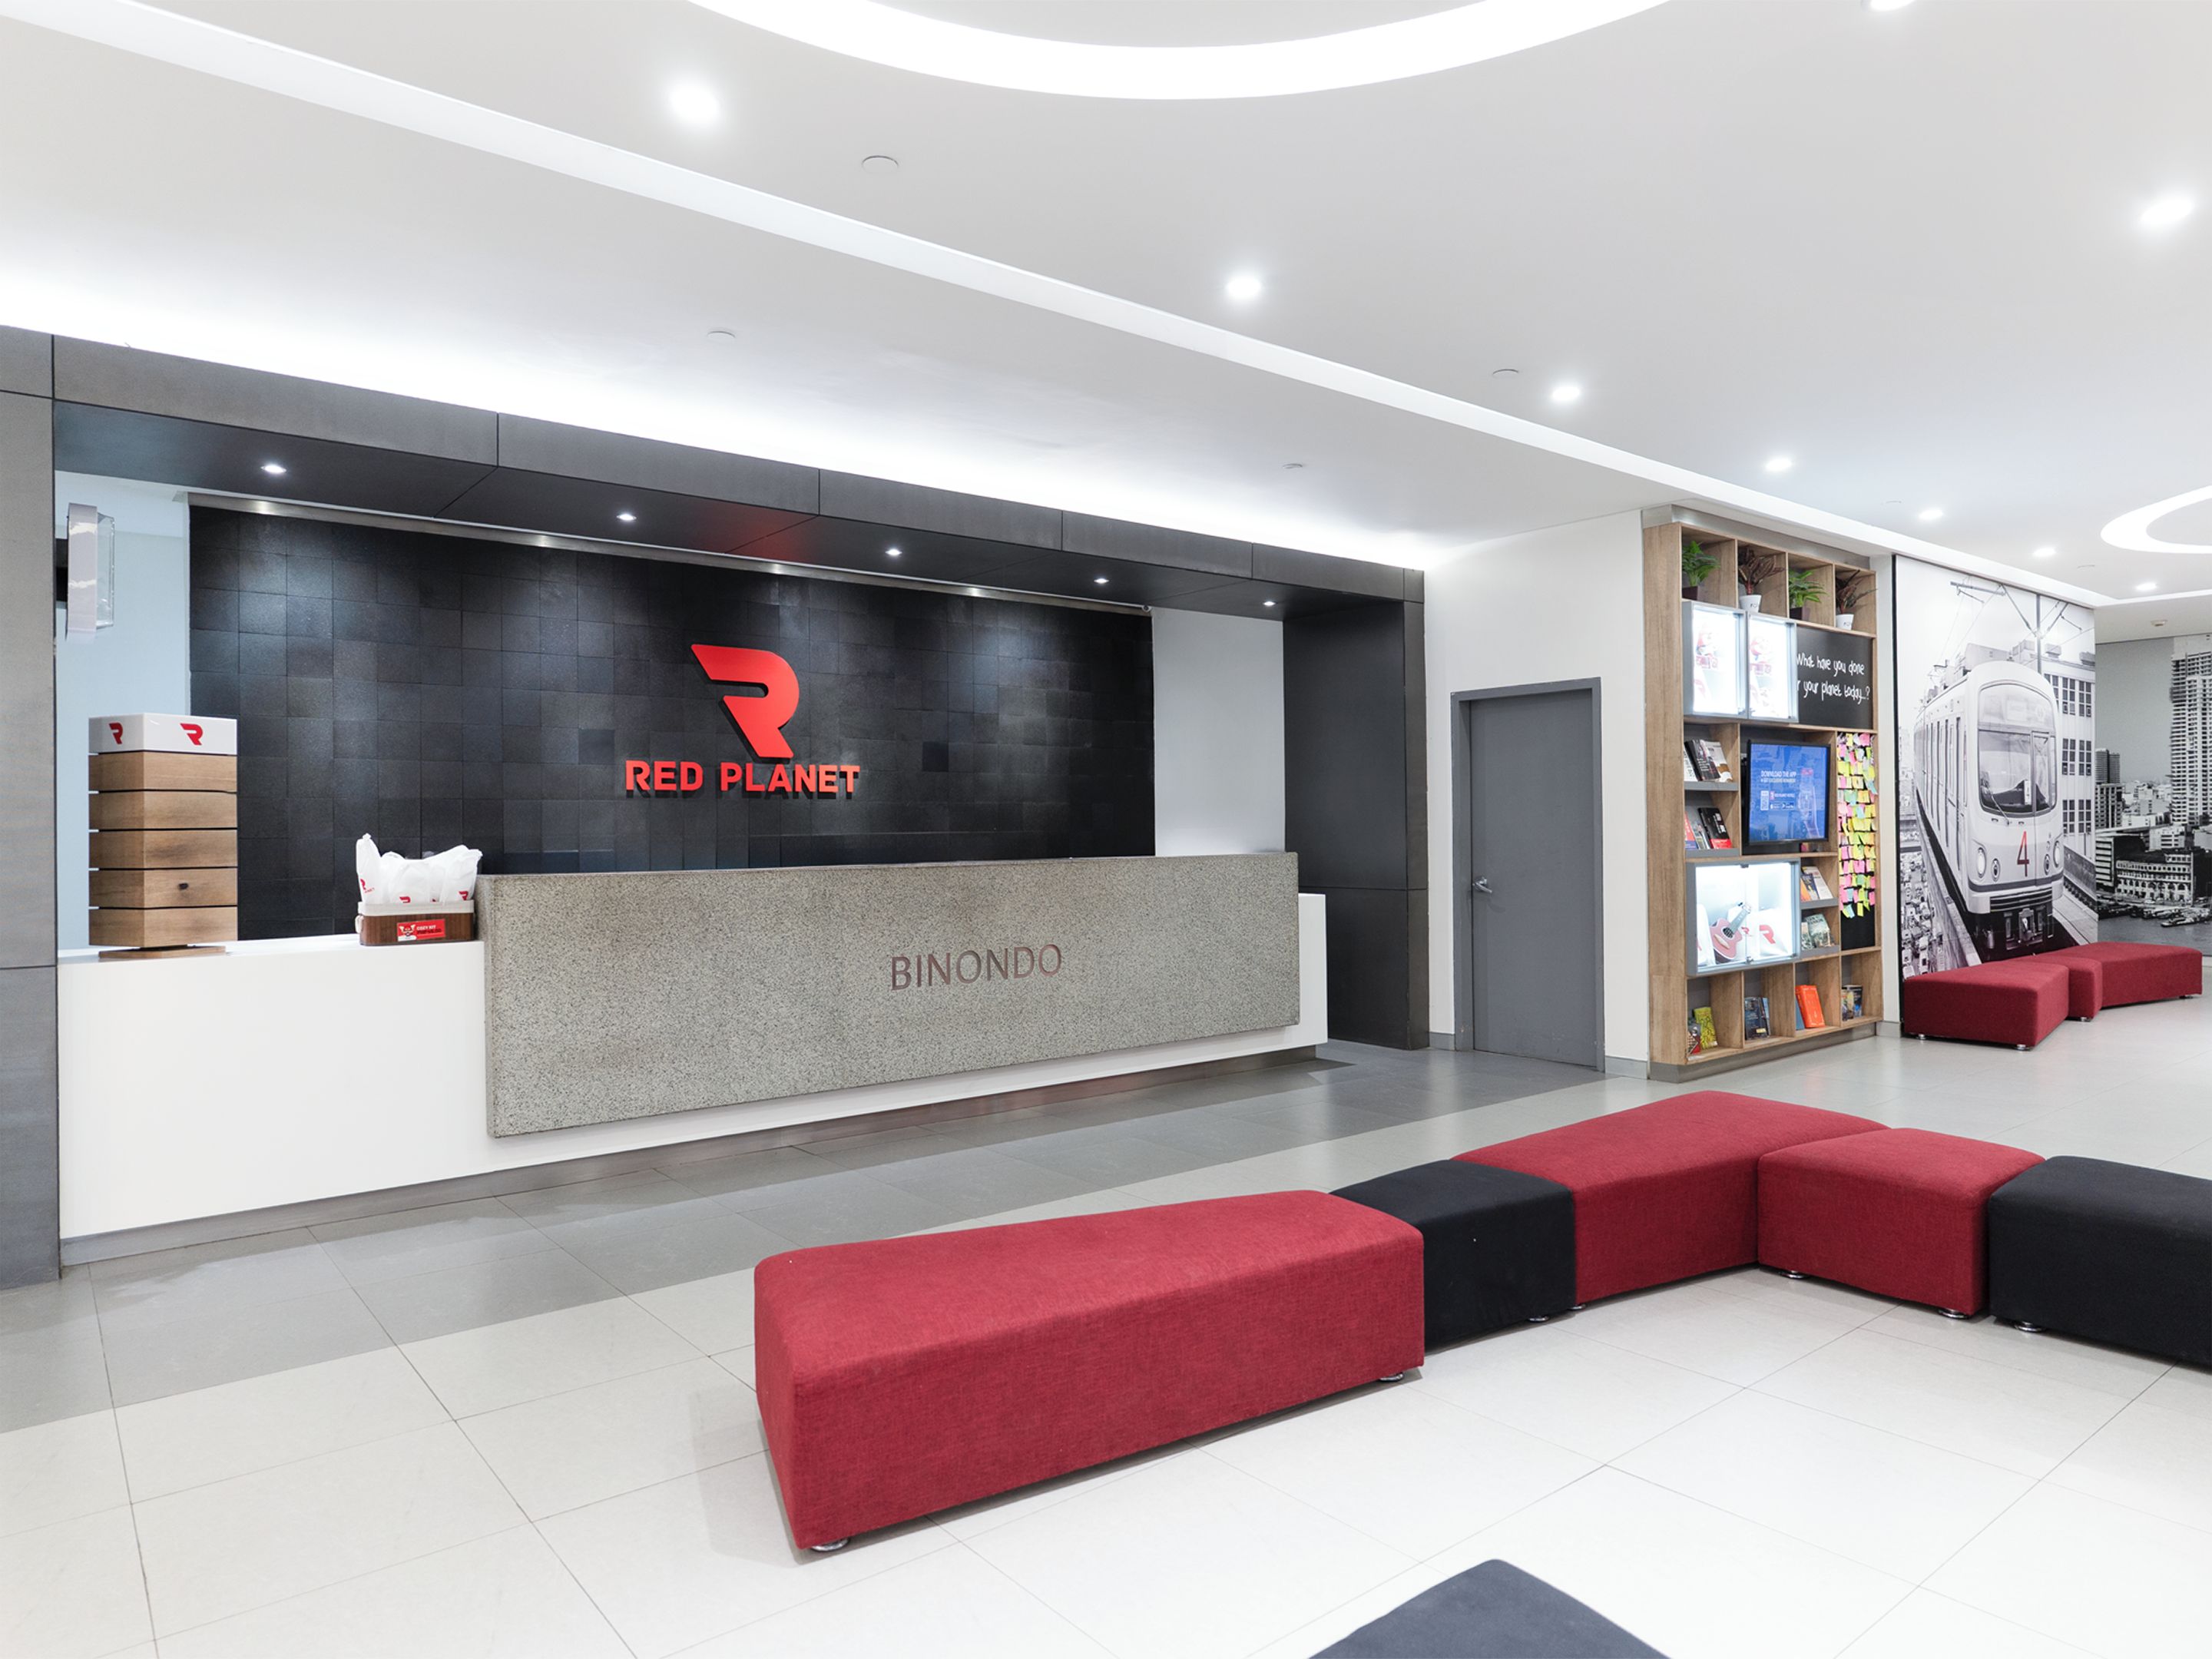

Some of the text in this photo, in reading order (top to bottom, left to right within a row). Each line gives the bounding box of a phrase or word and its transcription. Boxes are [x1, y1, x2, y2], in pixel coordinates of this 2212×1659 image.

[1796, 652, 1865, 677] What have you done
[690, 644, 800, 758] R
[1803, 680, 1819, 698] your
[1821, 680, 1842, 701] planet
[625, 759, 860, 793] RED PLANET
[2016, 830, 2030, 877] 4
[891, 943, 1062, 991] BINONDO
